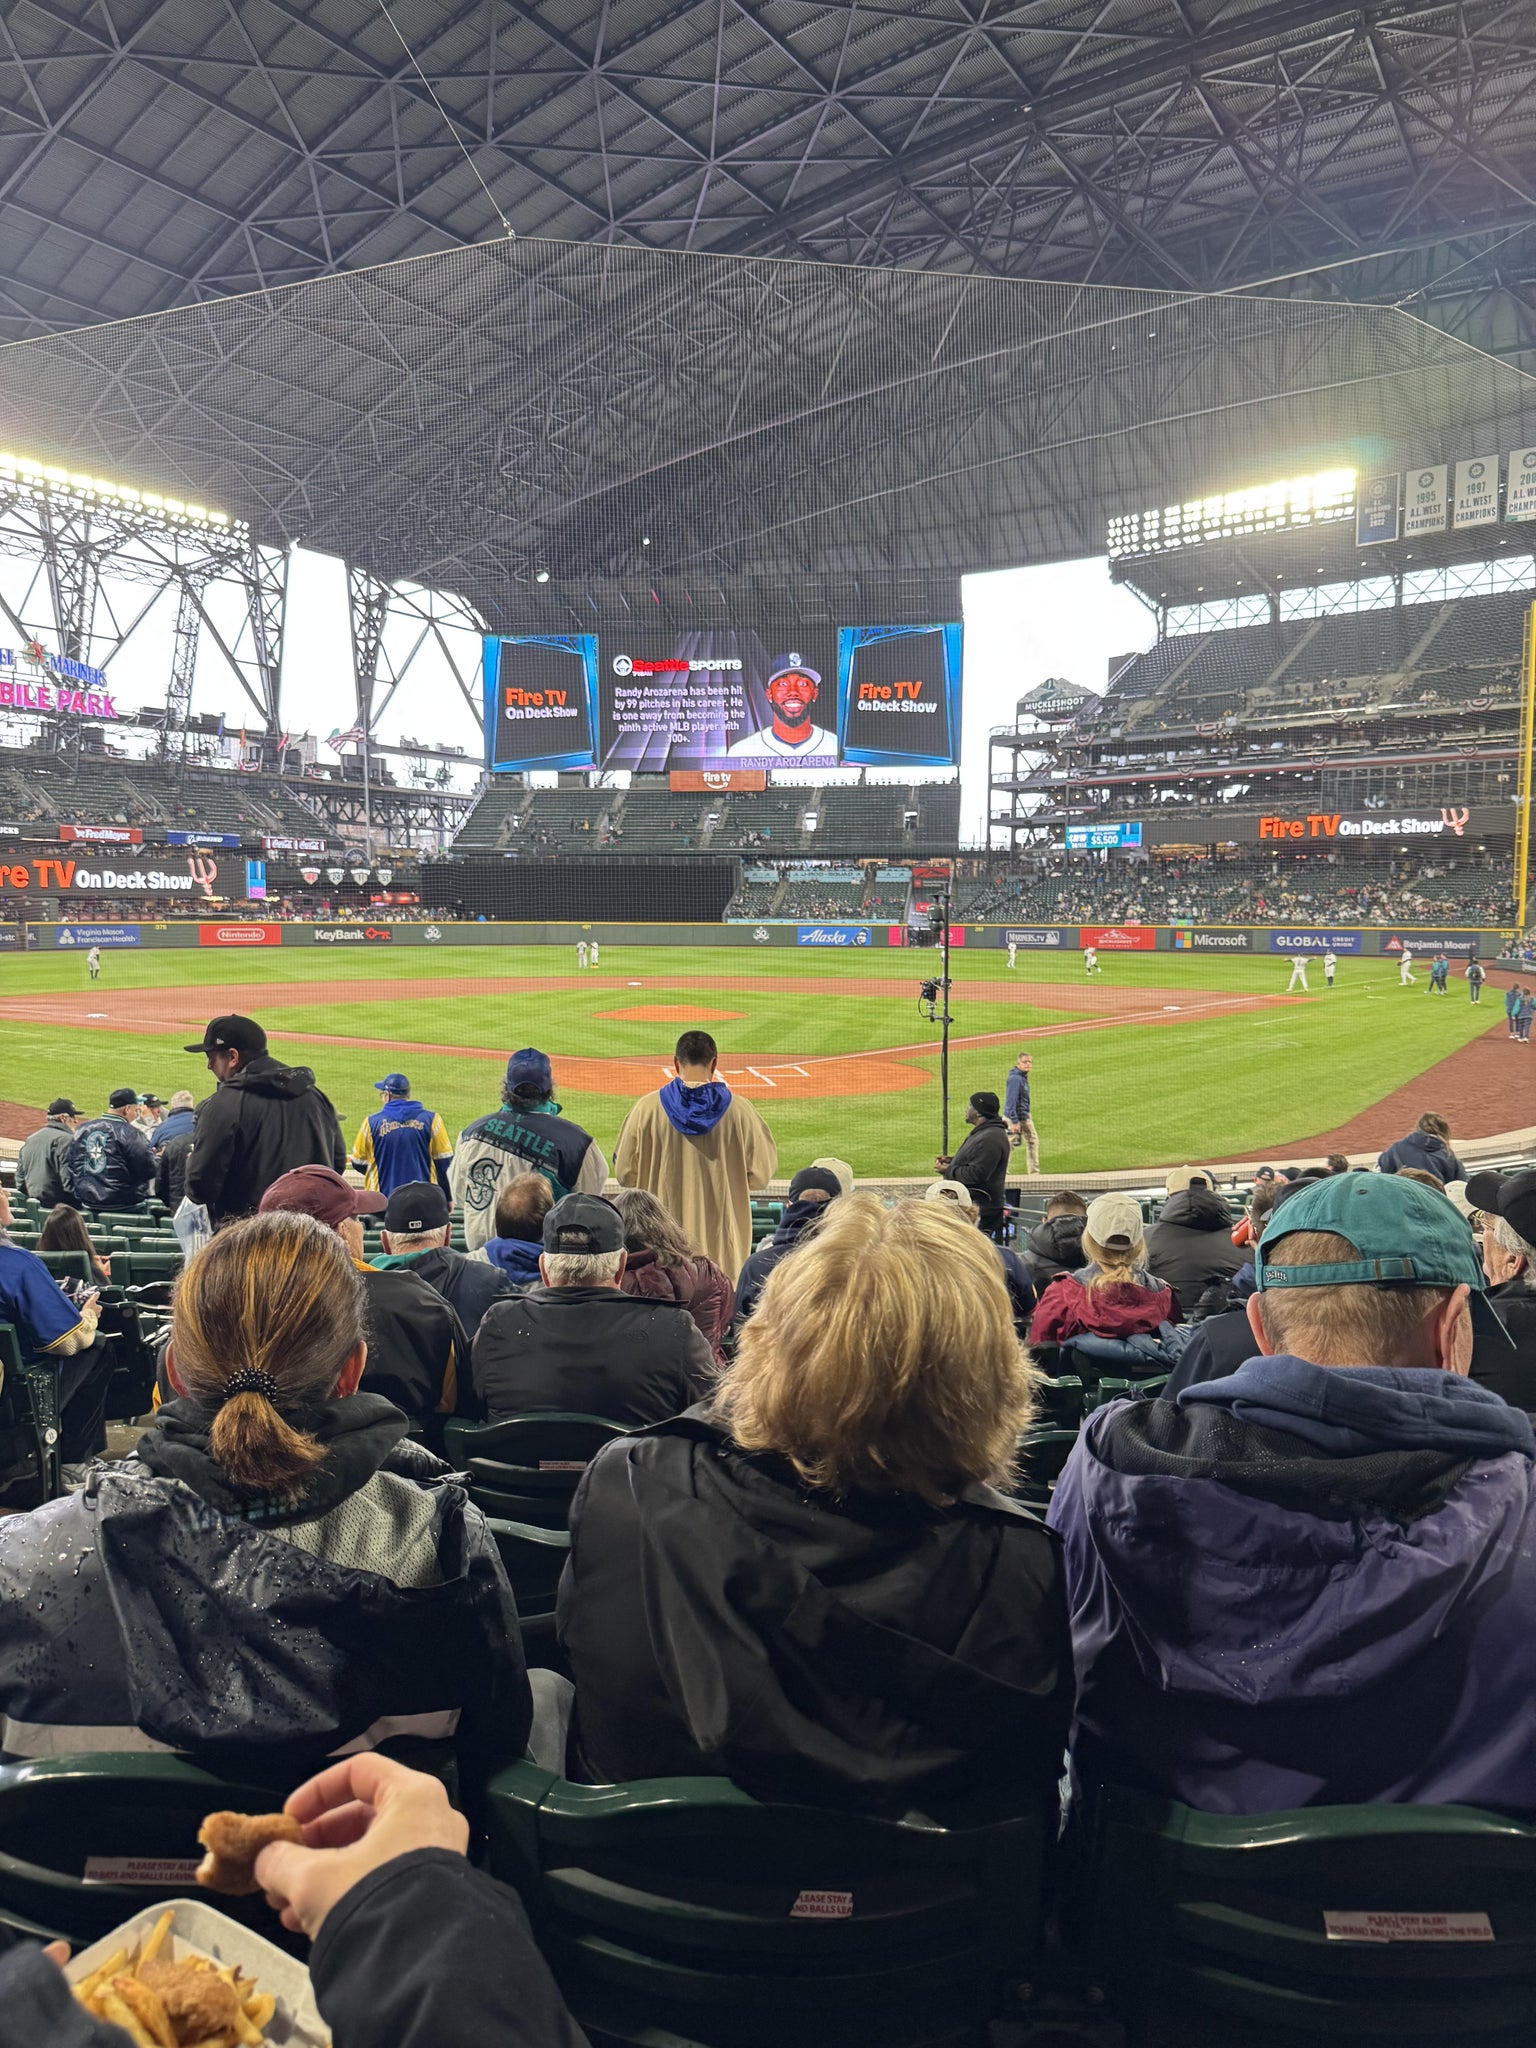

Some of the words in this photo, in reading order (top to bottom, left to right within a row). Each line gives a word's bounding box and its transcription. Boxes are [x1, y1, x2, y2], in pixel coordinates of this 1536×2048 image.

[1467, 482, 1486, 495] 1997
[1416, 491, 1436, 504] 1995
[1473, 495, 1492, 506] WEST
[1422, 504, 1441, 515] WEST
[1456, 507, 1497, 522] CHAMPIONS
[1406, 516, 1445, 531] CHAMPIONS
[49, 655, 107, 688] MARINERS
[615, 687, 642, 698] Randy
[643, 687, 688, 697] Arozarena
[689, 686, 706, 696] has
[707, 686, 729, 695] been
[731, 685, 743, 695] hit
[859, 683, 892, 699] Fire
[894, 681, 922, 699] TV
[0, 682, 51, 710] BILE
[57, 689, 118, 719] PARK
[505, 687, 544, 706] Fire
[544, 689, 567, 706] TV
[614, 699, 626, 710] by
[626, 699, 637, 708] 99
[639, 699, 671, 710] pitches
[671, 699, 680, 708] in
[682, 699, 696, 708] his
[730, 698, 743, 707] He
[858, 700, 872, 711] On
[872, 700, 900, 711] Deck
[901, 701, 937, 713] Show
[1025, 697, 1085, 710] MUCKLESHOOT
[505, 707, 524, 719] On
[524, 707, 553, 719] Deck
[553, 706, 578, 717] Show
[612, 711, 621, 720] is
[622, 712, 639, 720] one
[640, 712, 662, 721] away
[664, 710, 685, 719] from
[686, 710, 729, 720] becoming
[730, 709, 745, 719] the
[618, 723, 641, 732] ninth
[642, 722, 668, 731] active
[669, 722, 690, 731] MLB
[691, 722, 719, 733] player
[721, 721, 740, 730] with
[740, 757, 774, 768] RANDY
[775, 756, 836, 767] AROZARENA
[703, 772, 720, 782] fire
[720, 772, 731, 782] tv
[1259, 816, 1304, 838] Fire
[1307, 815, 1341, 837] TV
[1339, 822, 1360, 835] On
[1361, 819, 1400, 835] Deck
[1401, 818, 1444, 834] Show
[1091, 835, 1118, 845] $5,500
[32, 860, 75, 888] TV
[75, 869, 101, 889] On
[103, 870, 147, 889] Deck
[147, 870, 193, 890] Show
[76, 929, 102, 937] Virginia
[314, 929, 364, 941] KeyBank
[801, 930, 846, 944] Alaska
[1500, 931, 1514, 939] 326
[1194, 934, 1247, 947] Microsoft
[1276, 936, 1330, 947] GLOBAL
[1403, 940, 1443, 950] Benjamin
[483, 1118, 555, 1157] SEATTLE
[128, 1861, 156, 1871] PLEASE
[158, 1862, 176, 1871] STAY
[100, 1870, 118, 1880] BATS
[120, 1871, 138, 1880] AND
[140, 1871, 163, 1880] BALLS
[828, 1895, 847, 1904] STAY
[810, 1904, 836, 1914] BALLS
